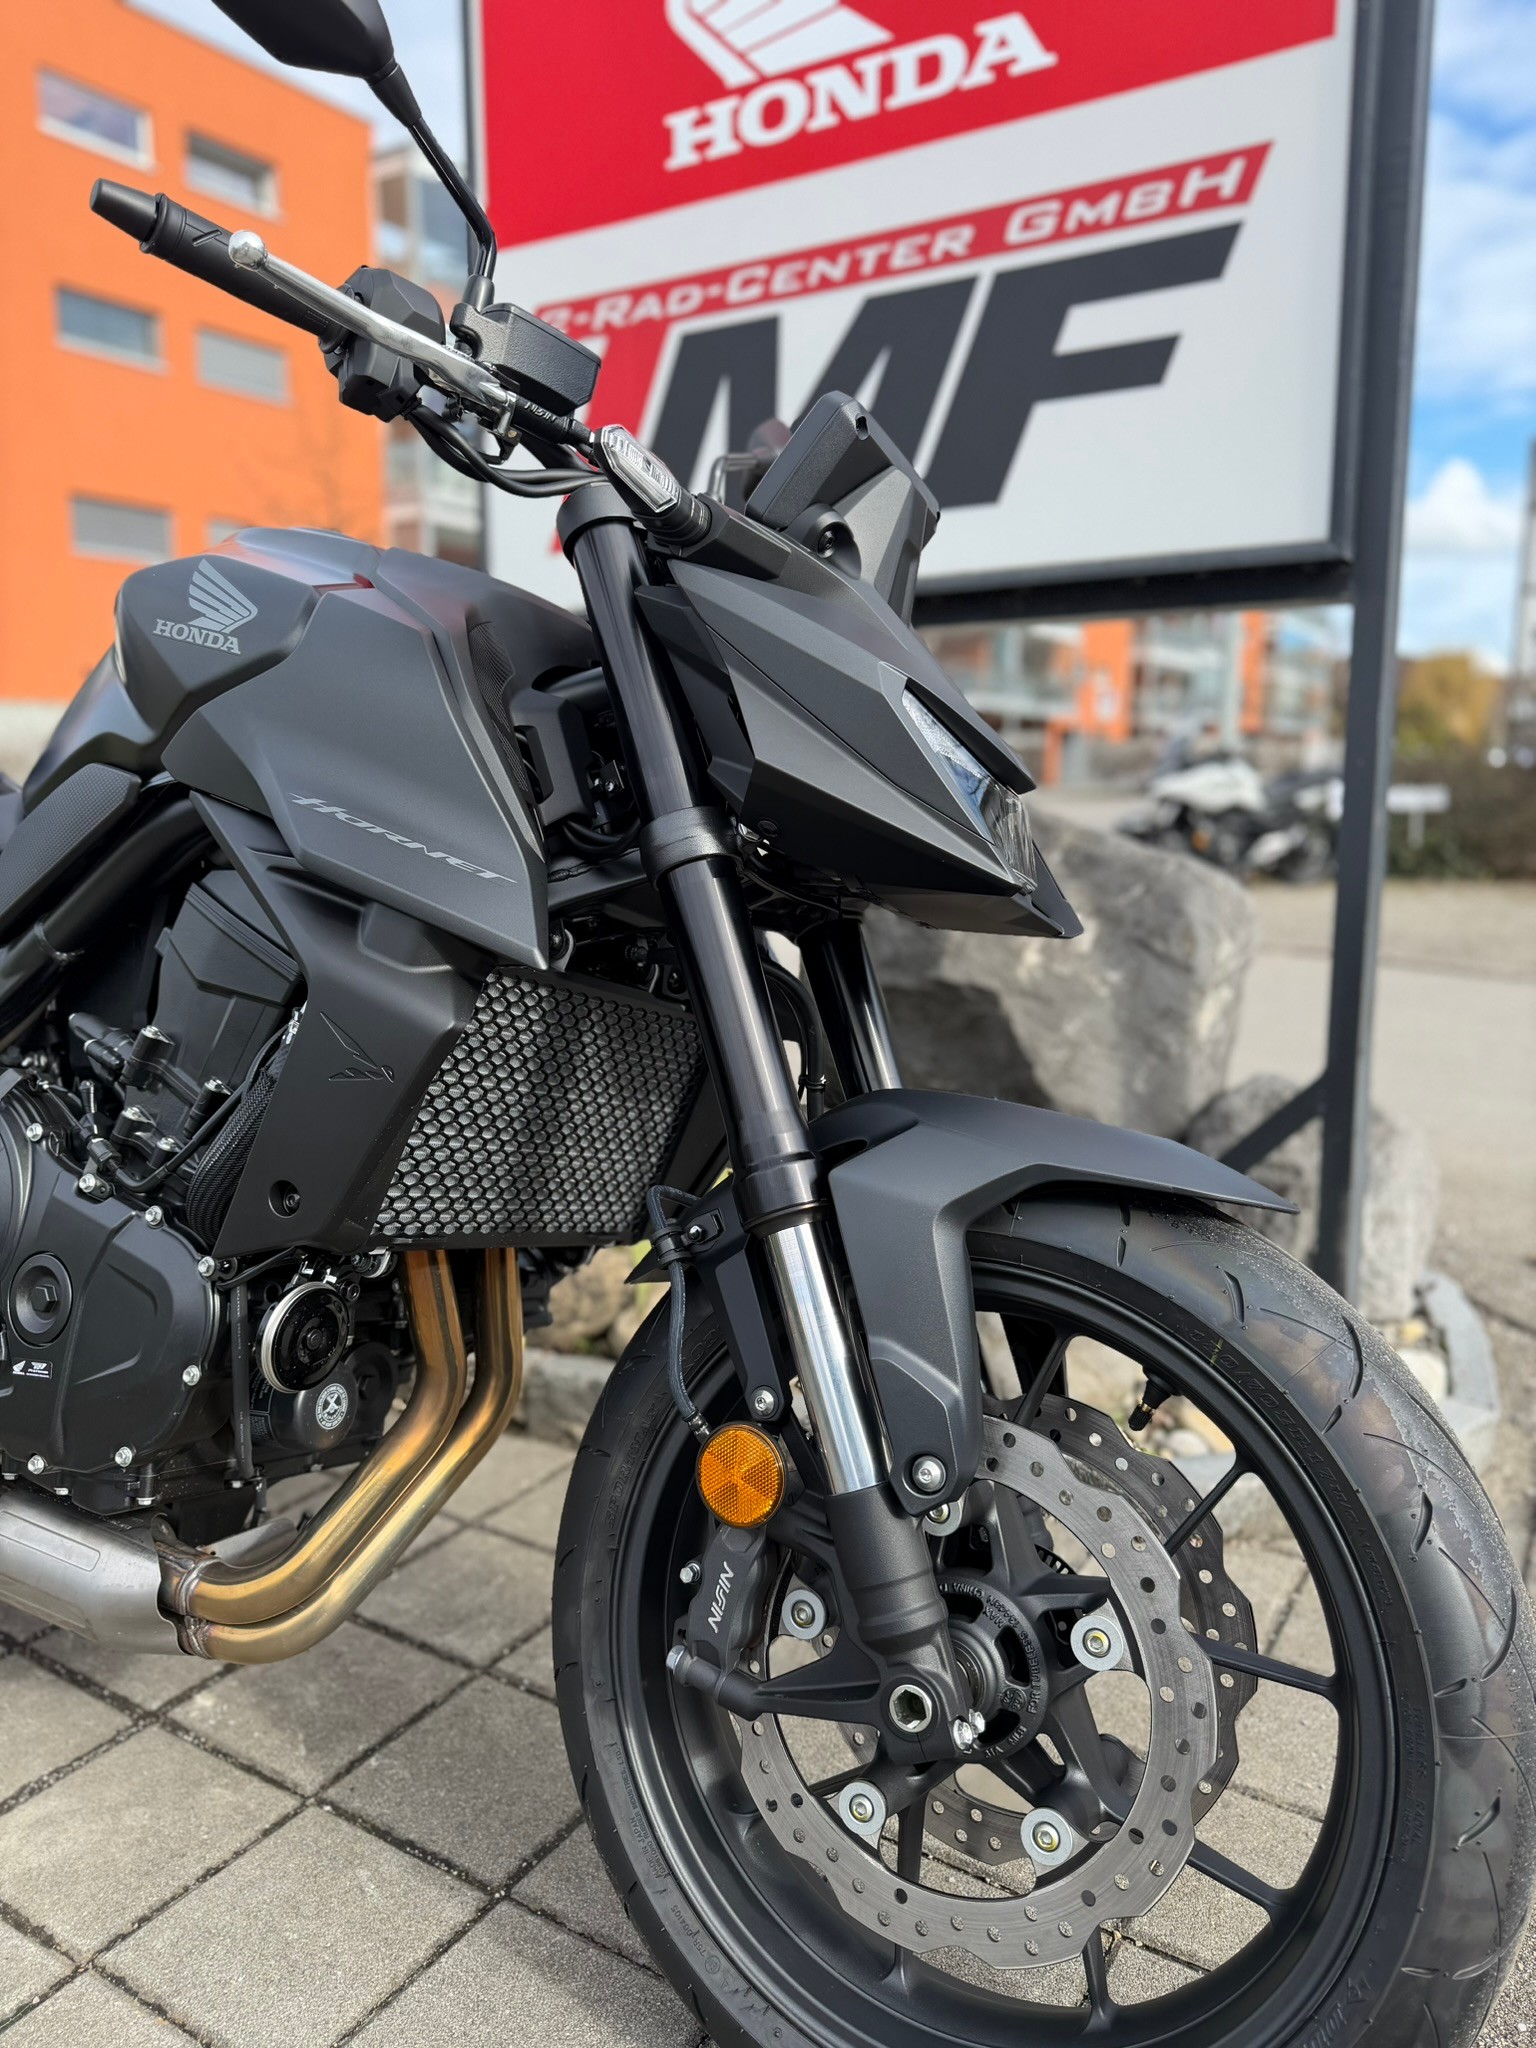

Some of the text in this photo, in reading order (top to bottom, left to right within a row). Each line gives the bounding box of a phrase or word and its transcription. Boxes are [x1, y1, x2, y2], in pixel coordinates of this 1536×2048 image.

[664, 11, 1058, 171] HONDA
[153, 619, 241, 654] HONDA
[605, 1402, 660, 1528] SPORTMAX
[707, 1561, 734, 1633] NISSIN
[1019, 1630, 1040, 1689] TUBELESS
[629, 1817, 645, 1843] JAPAN
